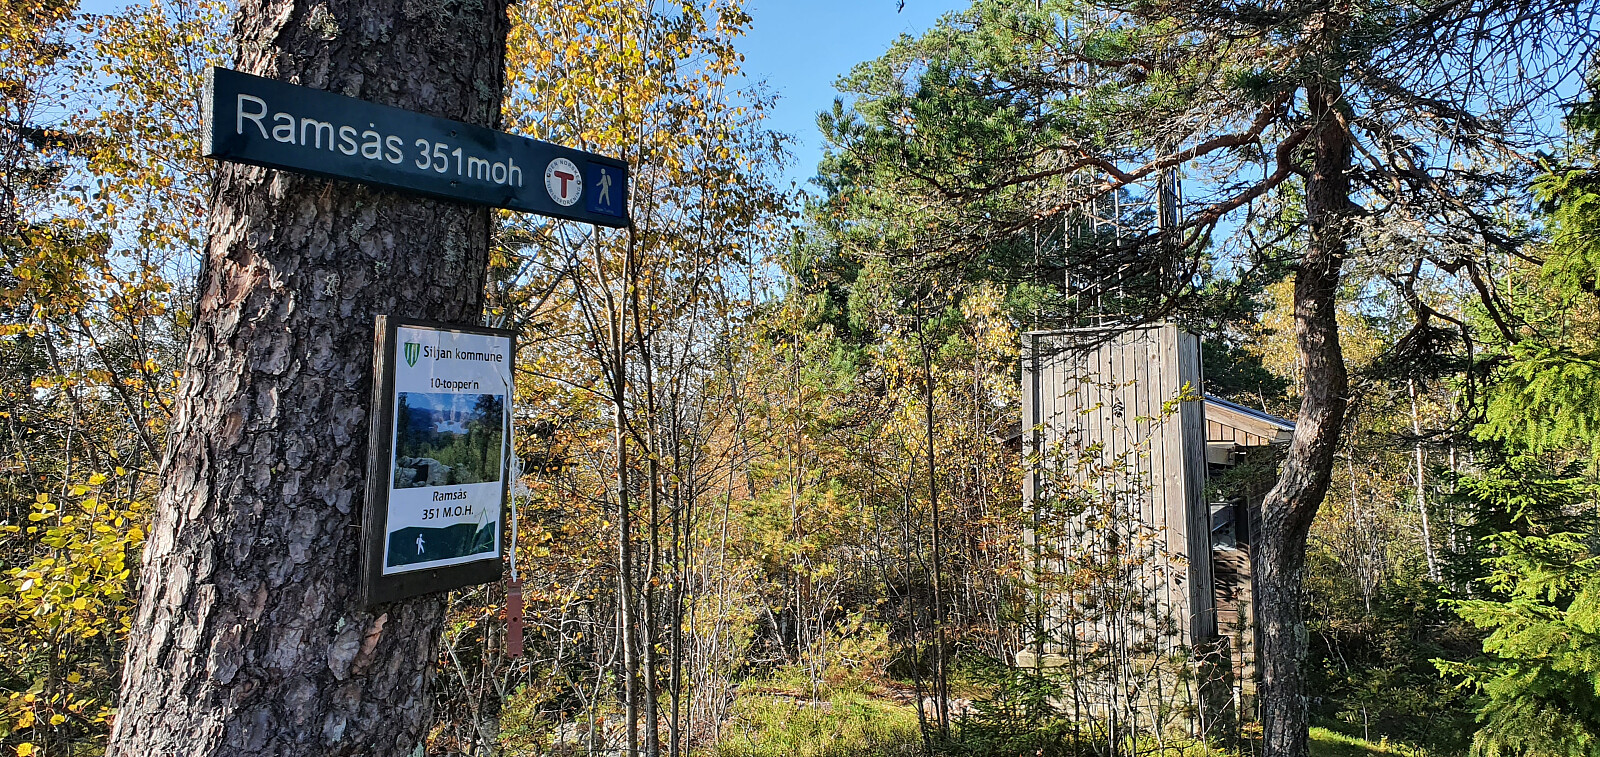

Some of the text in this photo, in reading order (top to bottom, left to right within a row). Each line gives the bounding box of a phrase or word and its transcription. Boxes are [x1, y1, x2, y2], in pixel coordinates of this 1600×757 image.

[237, 93, 404, 164] Ramsås
[548, 160, 580, 179] DEN NORSKE
[554, 170, 575, 199] T
[423, 346, 503, 362] Siljan kommune
[433, 488, 467, 501] Ramsås
[422, 505, 474, 520] 351 M.O.H.
